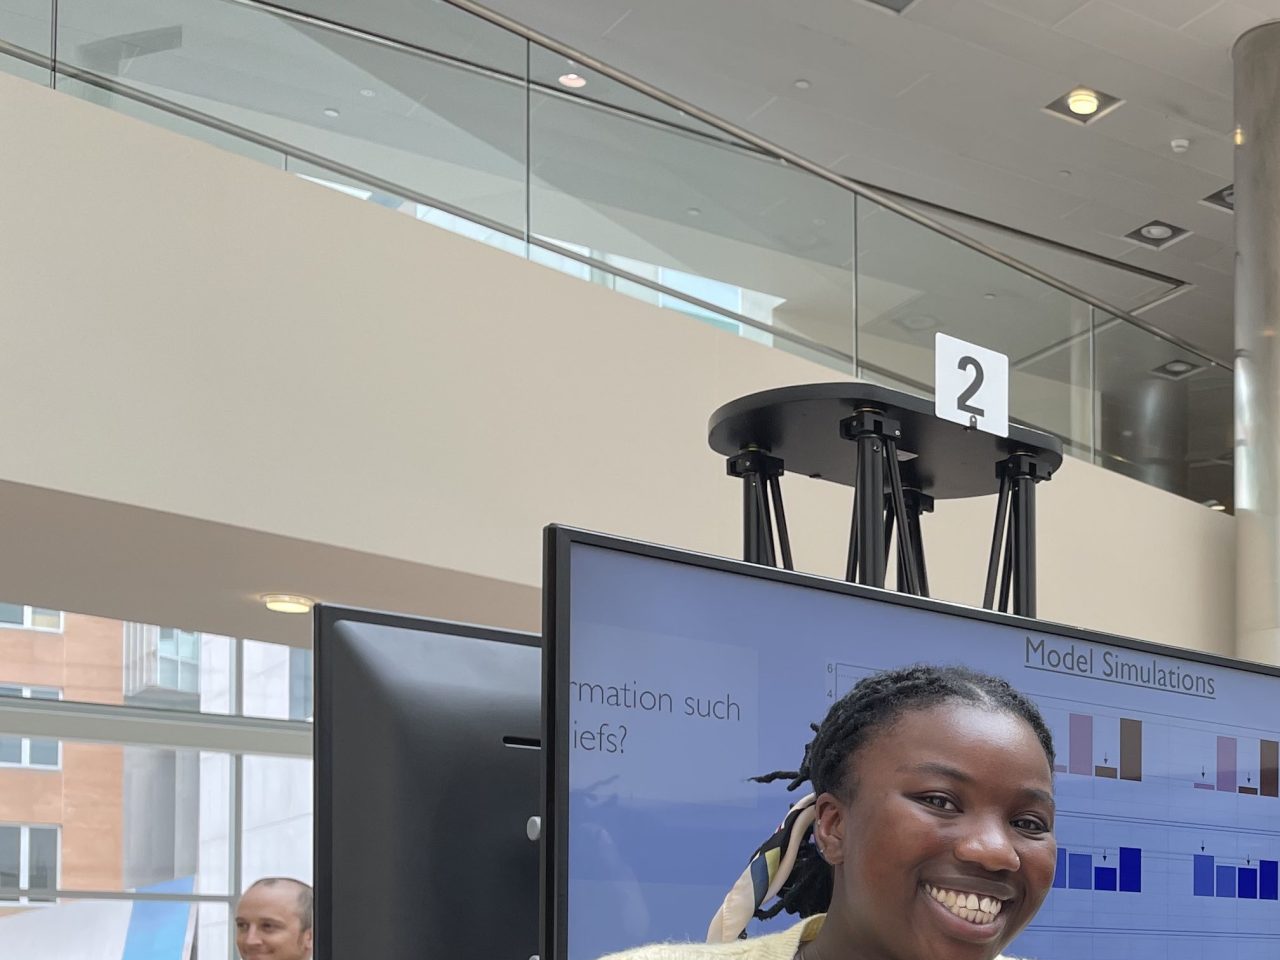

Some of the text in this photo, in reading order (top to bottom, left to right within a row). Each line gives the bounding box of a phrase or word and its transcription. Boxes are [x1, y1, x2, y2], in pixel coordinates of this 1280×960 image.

[957, 355, 985, 418] 2
[1025, 636, 1215, 696] Model Simulations
[684, 694, 741, 721] such
[826, 689, 833, 698] 4
[573, 720, 627, 754] iefs?
